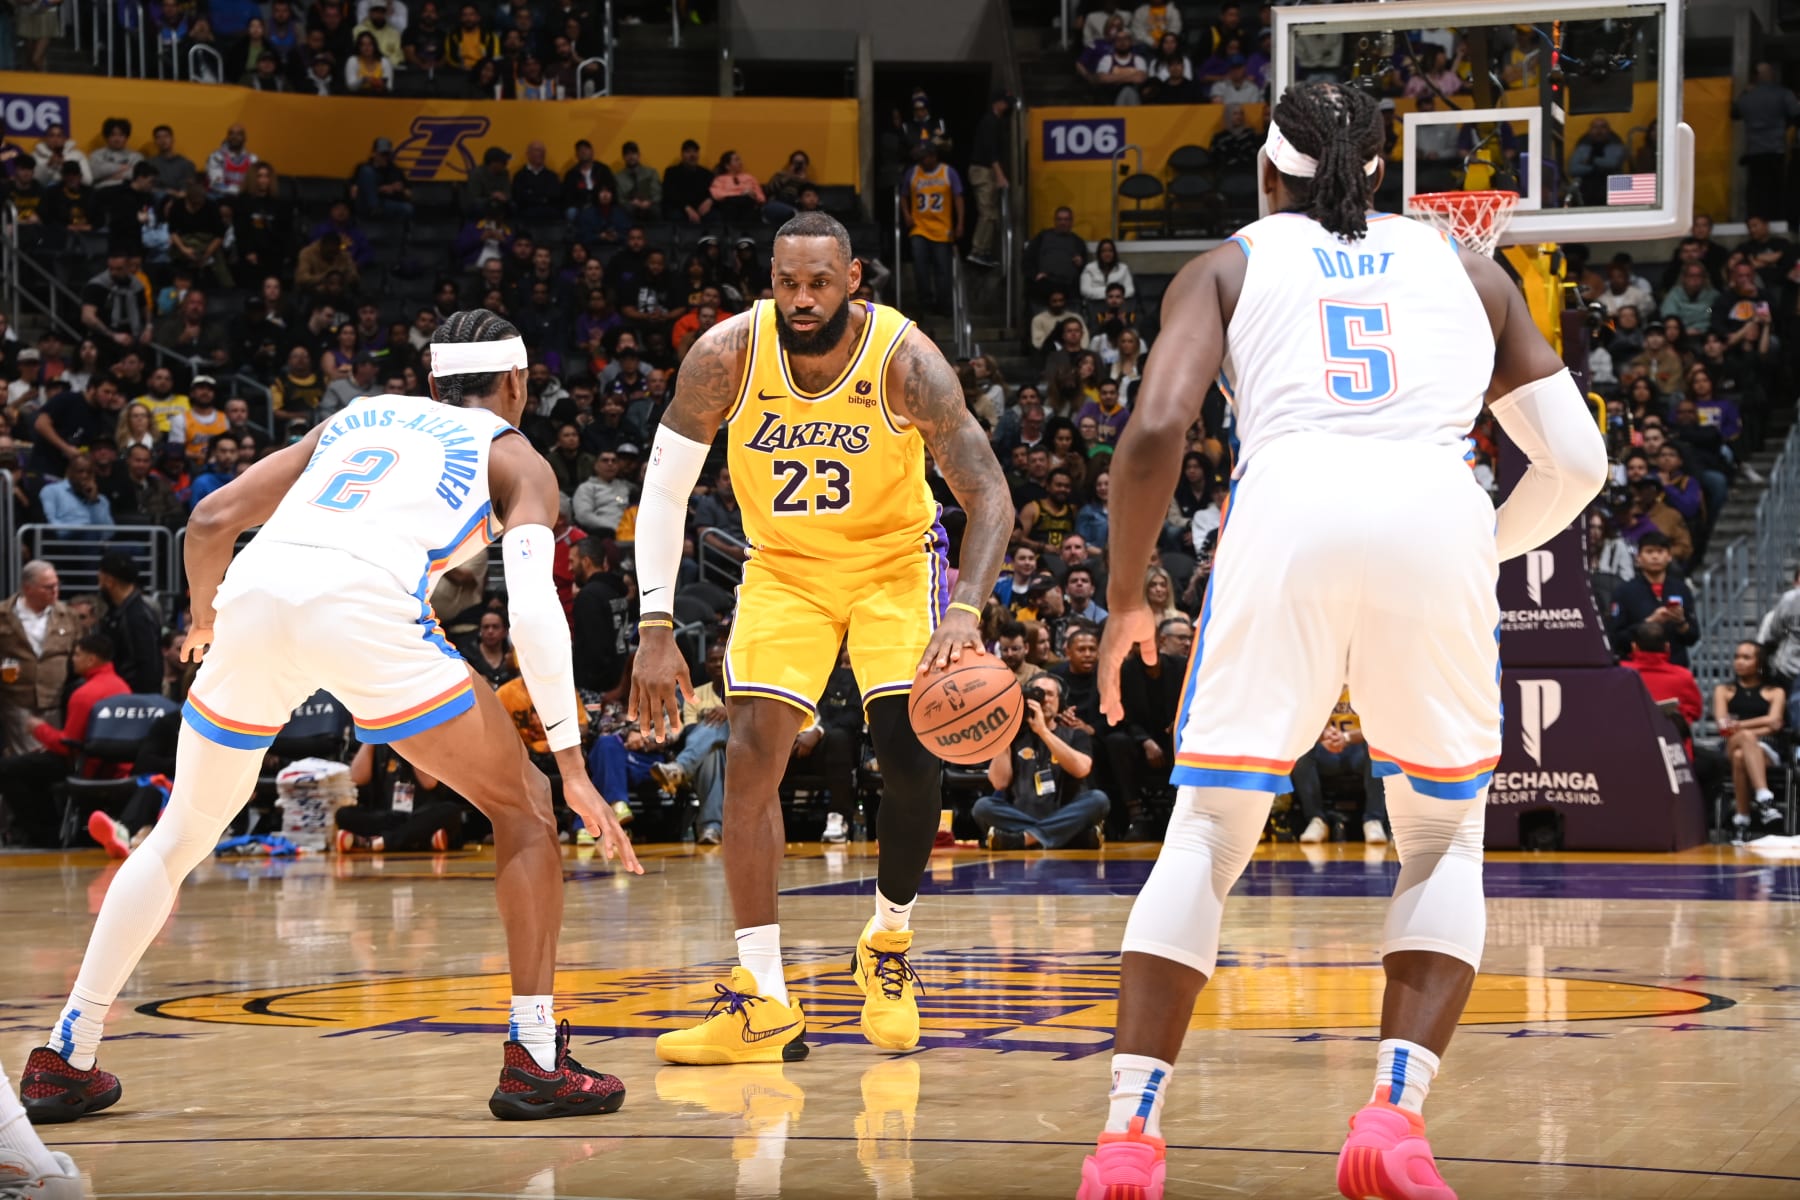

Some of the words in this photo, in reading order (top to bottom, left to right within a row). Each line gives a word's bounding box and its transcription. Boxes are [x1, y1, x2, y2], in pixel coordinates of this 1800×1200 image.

[0, 99, 62, 131] 06
[1051, 124, 1118, 154] 106
[916, 192, 944, 212] 32
[1312, 247, 1395, 279] DORT
[1319, 299, 1398, 406] 5
[848, 395, 877, 408] bibigo
[307, 447, 400, 512] 2
[772, 459, 852, 516] 23
[115, 706, 165, 719] DELTA
[295, 703, 334, 716] ELTA
[936, 706, 1010, 746] Wilson
